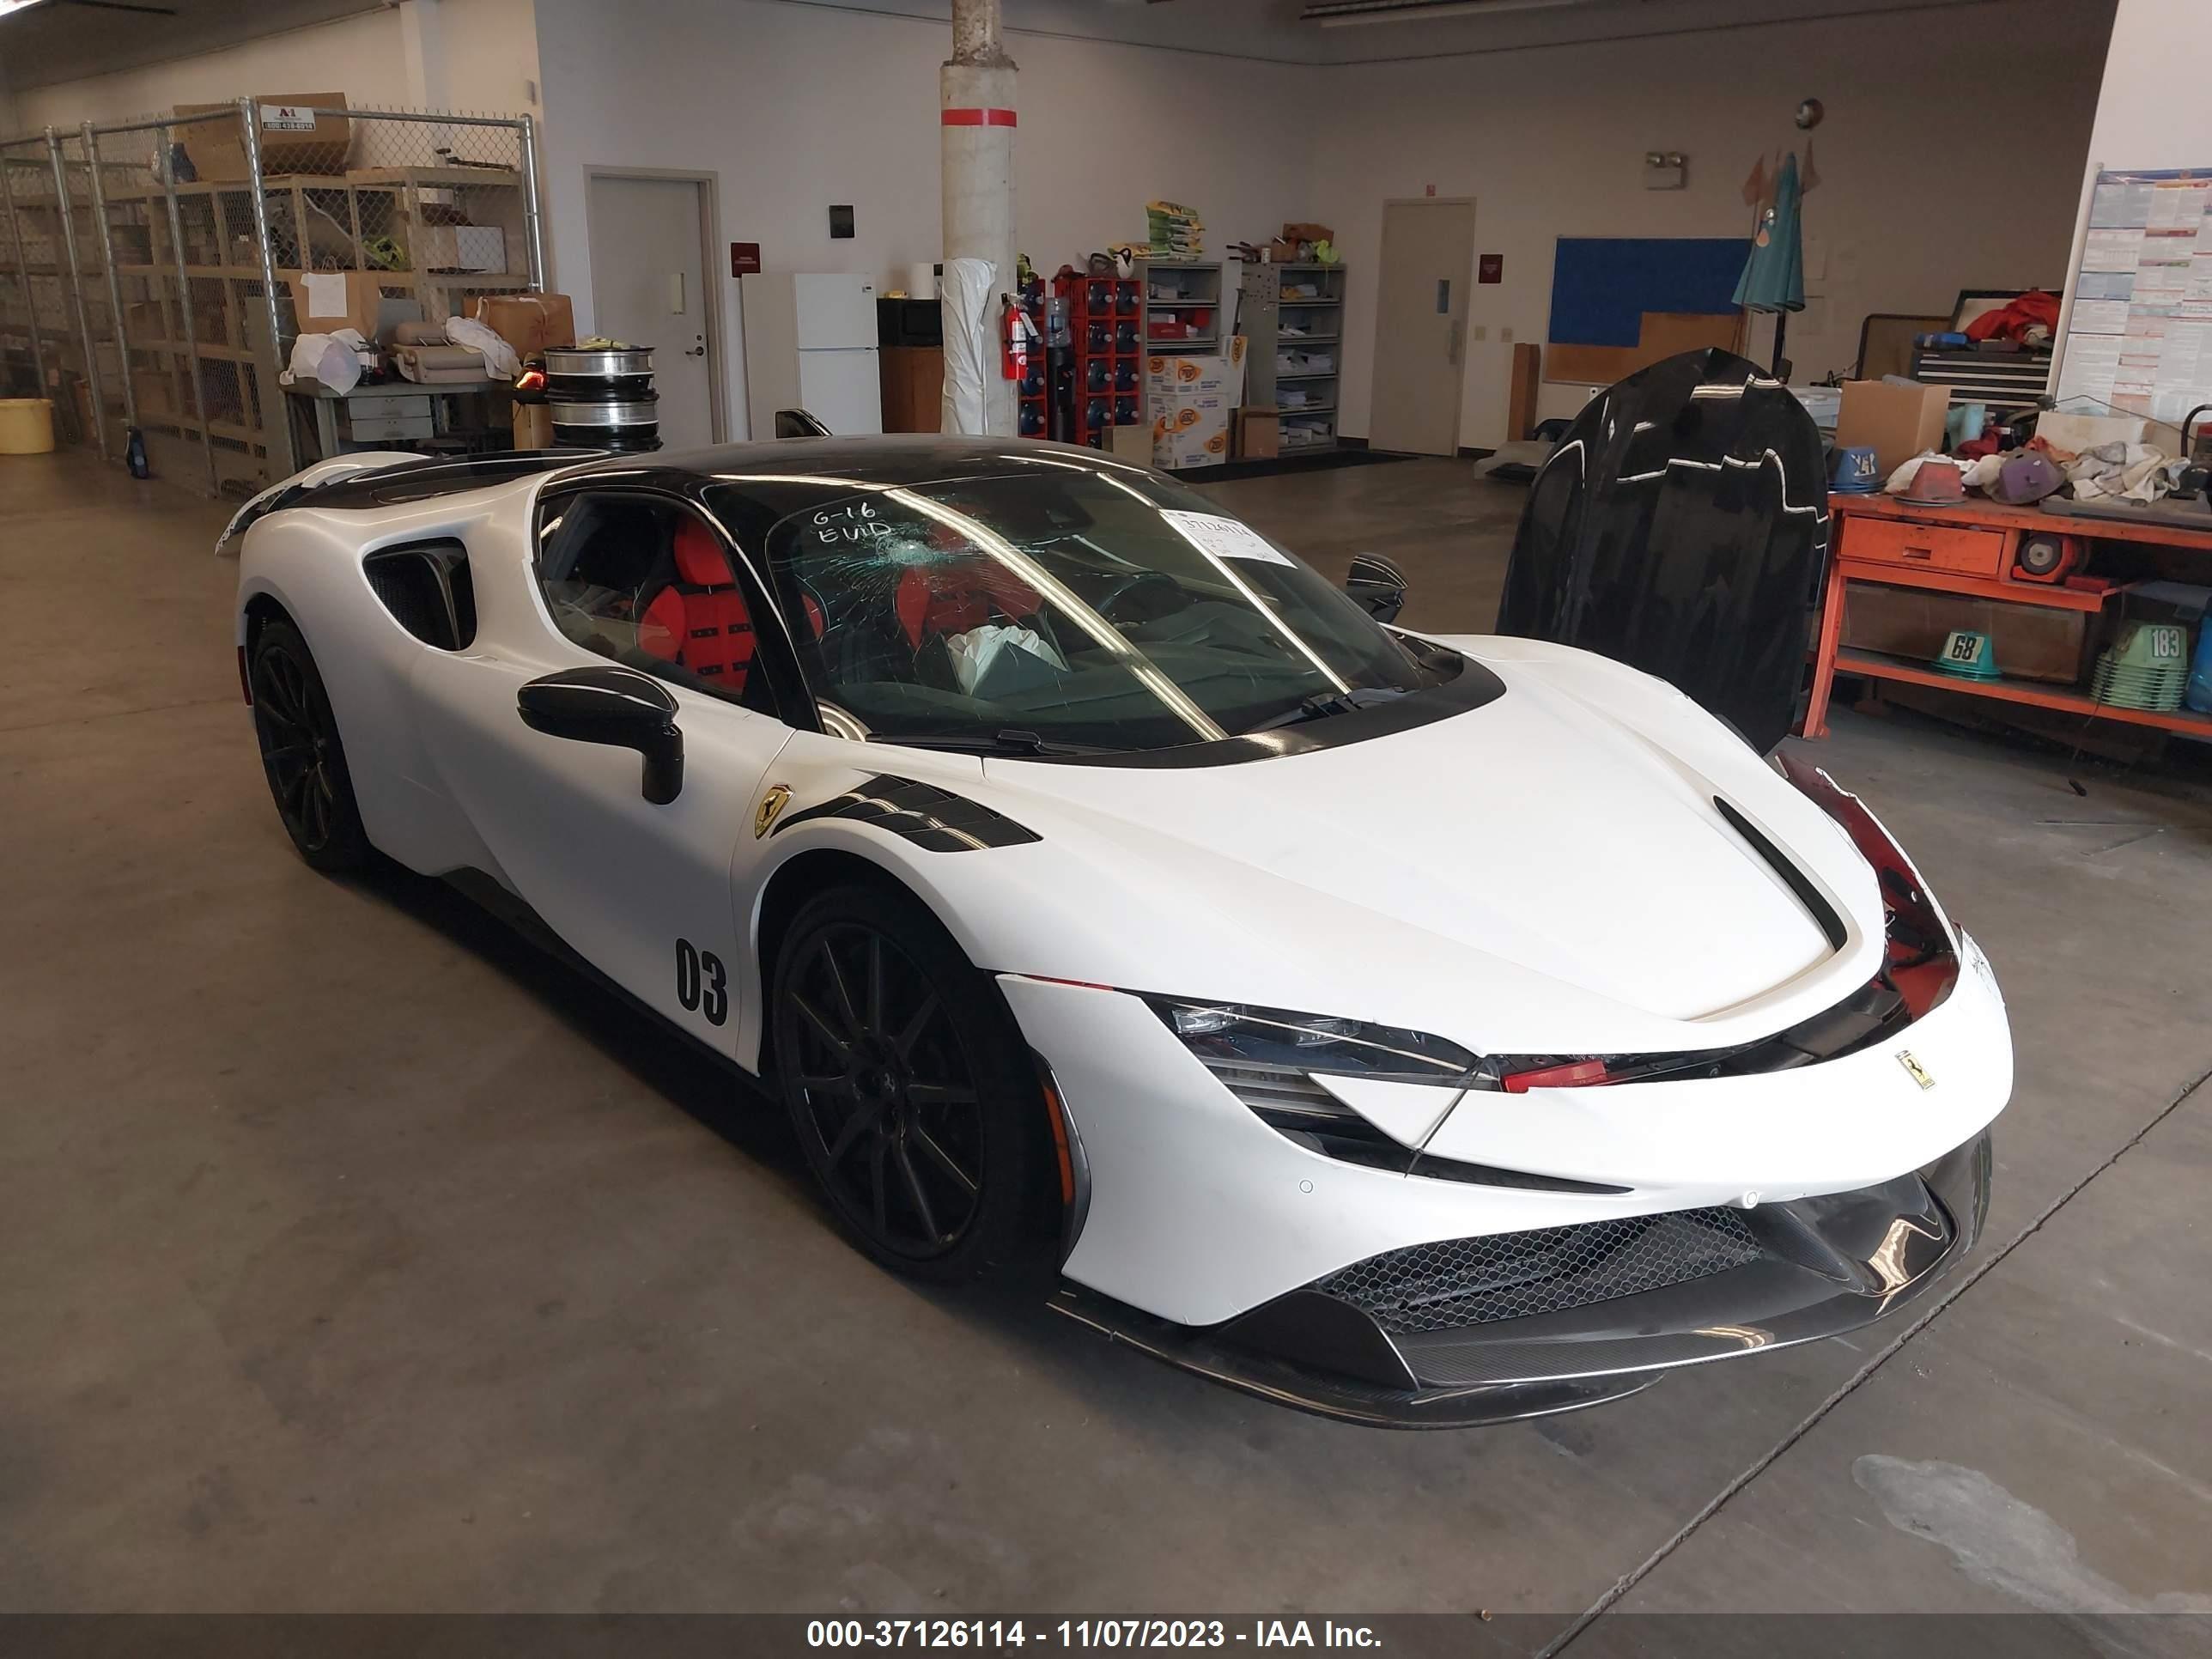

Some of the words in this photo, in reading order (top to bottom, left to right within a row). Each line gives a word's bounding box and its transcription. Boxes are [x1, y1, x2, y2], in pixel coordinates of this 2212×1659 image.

[1182, 519, 1252, 538] 37126114
[1951, 635, 1977, 660] 68
[2152, 629, 2179, 657] 183
[675, 938, 728, 1026] 03
